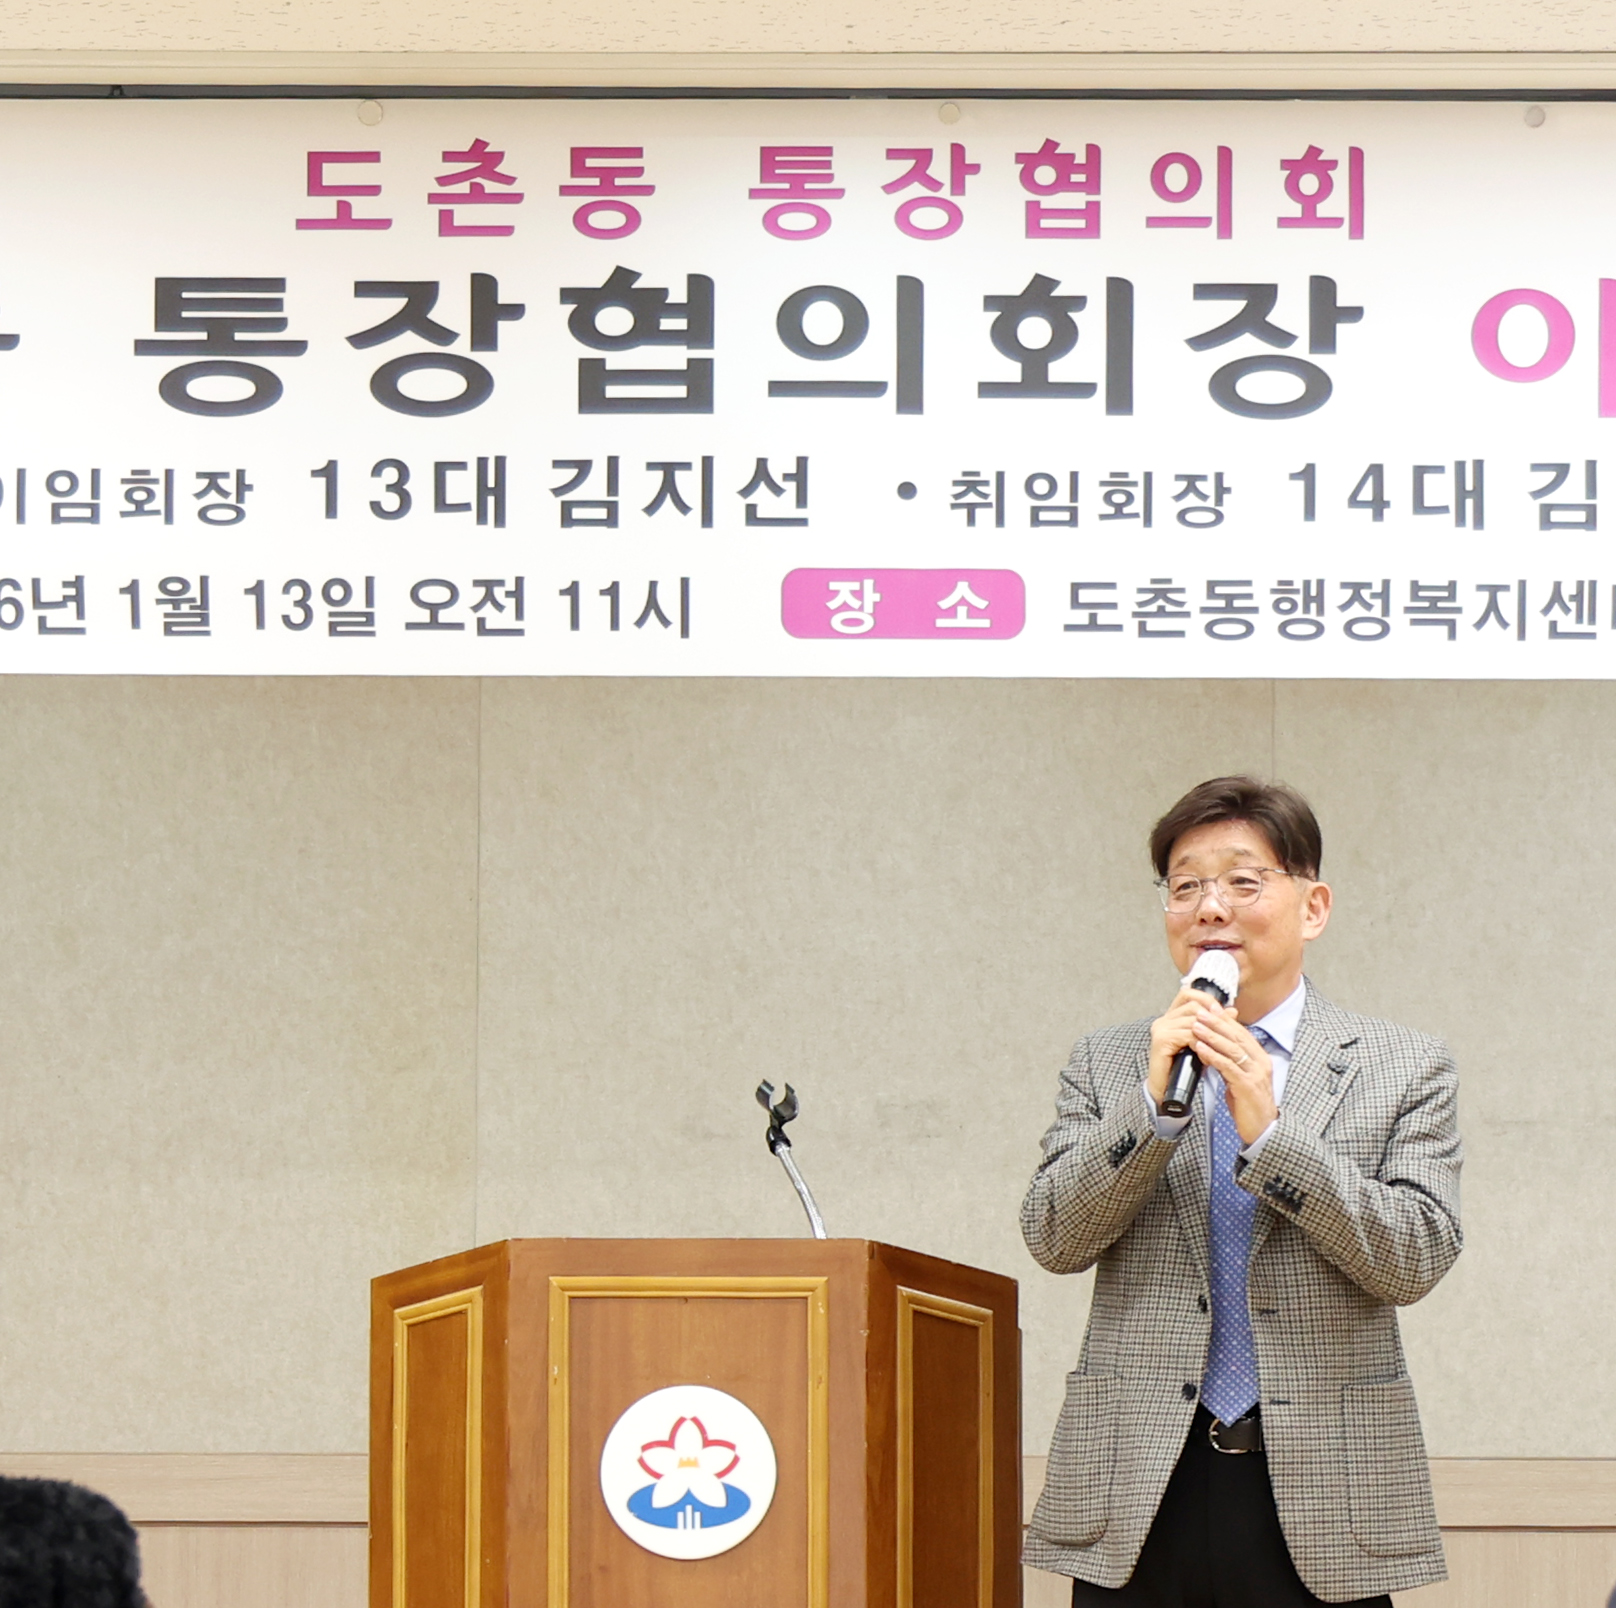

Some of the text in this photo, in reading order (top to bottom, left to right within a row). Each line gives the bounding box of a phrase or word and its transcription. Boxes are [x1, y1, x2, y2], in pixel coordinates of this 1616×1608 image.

[295, 137, 1365, 241] 도촌동 통장협의회
[133, 264, 1365, 421] 통장협의회장
[310, 454, 508, 529] 13대
[549, 454, 809, 529] 김지선
[949, 470, 1232, 529] 취임회장
[1288, 458, 1485, 531] 14대
[118, 574, 212, 637] 1월
[243, 575, 377, 638] 13일
[404, 575, 526, 637] 오전
[558, 576, 690, 640] 11시
